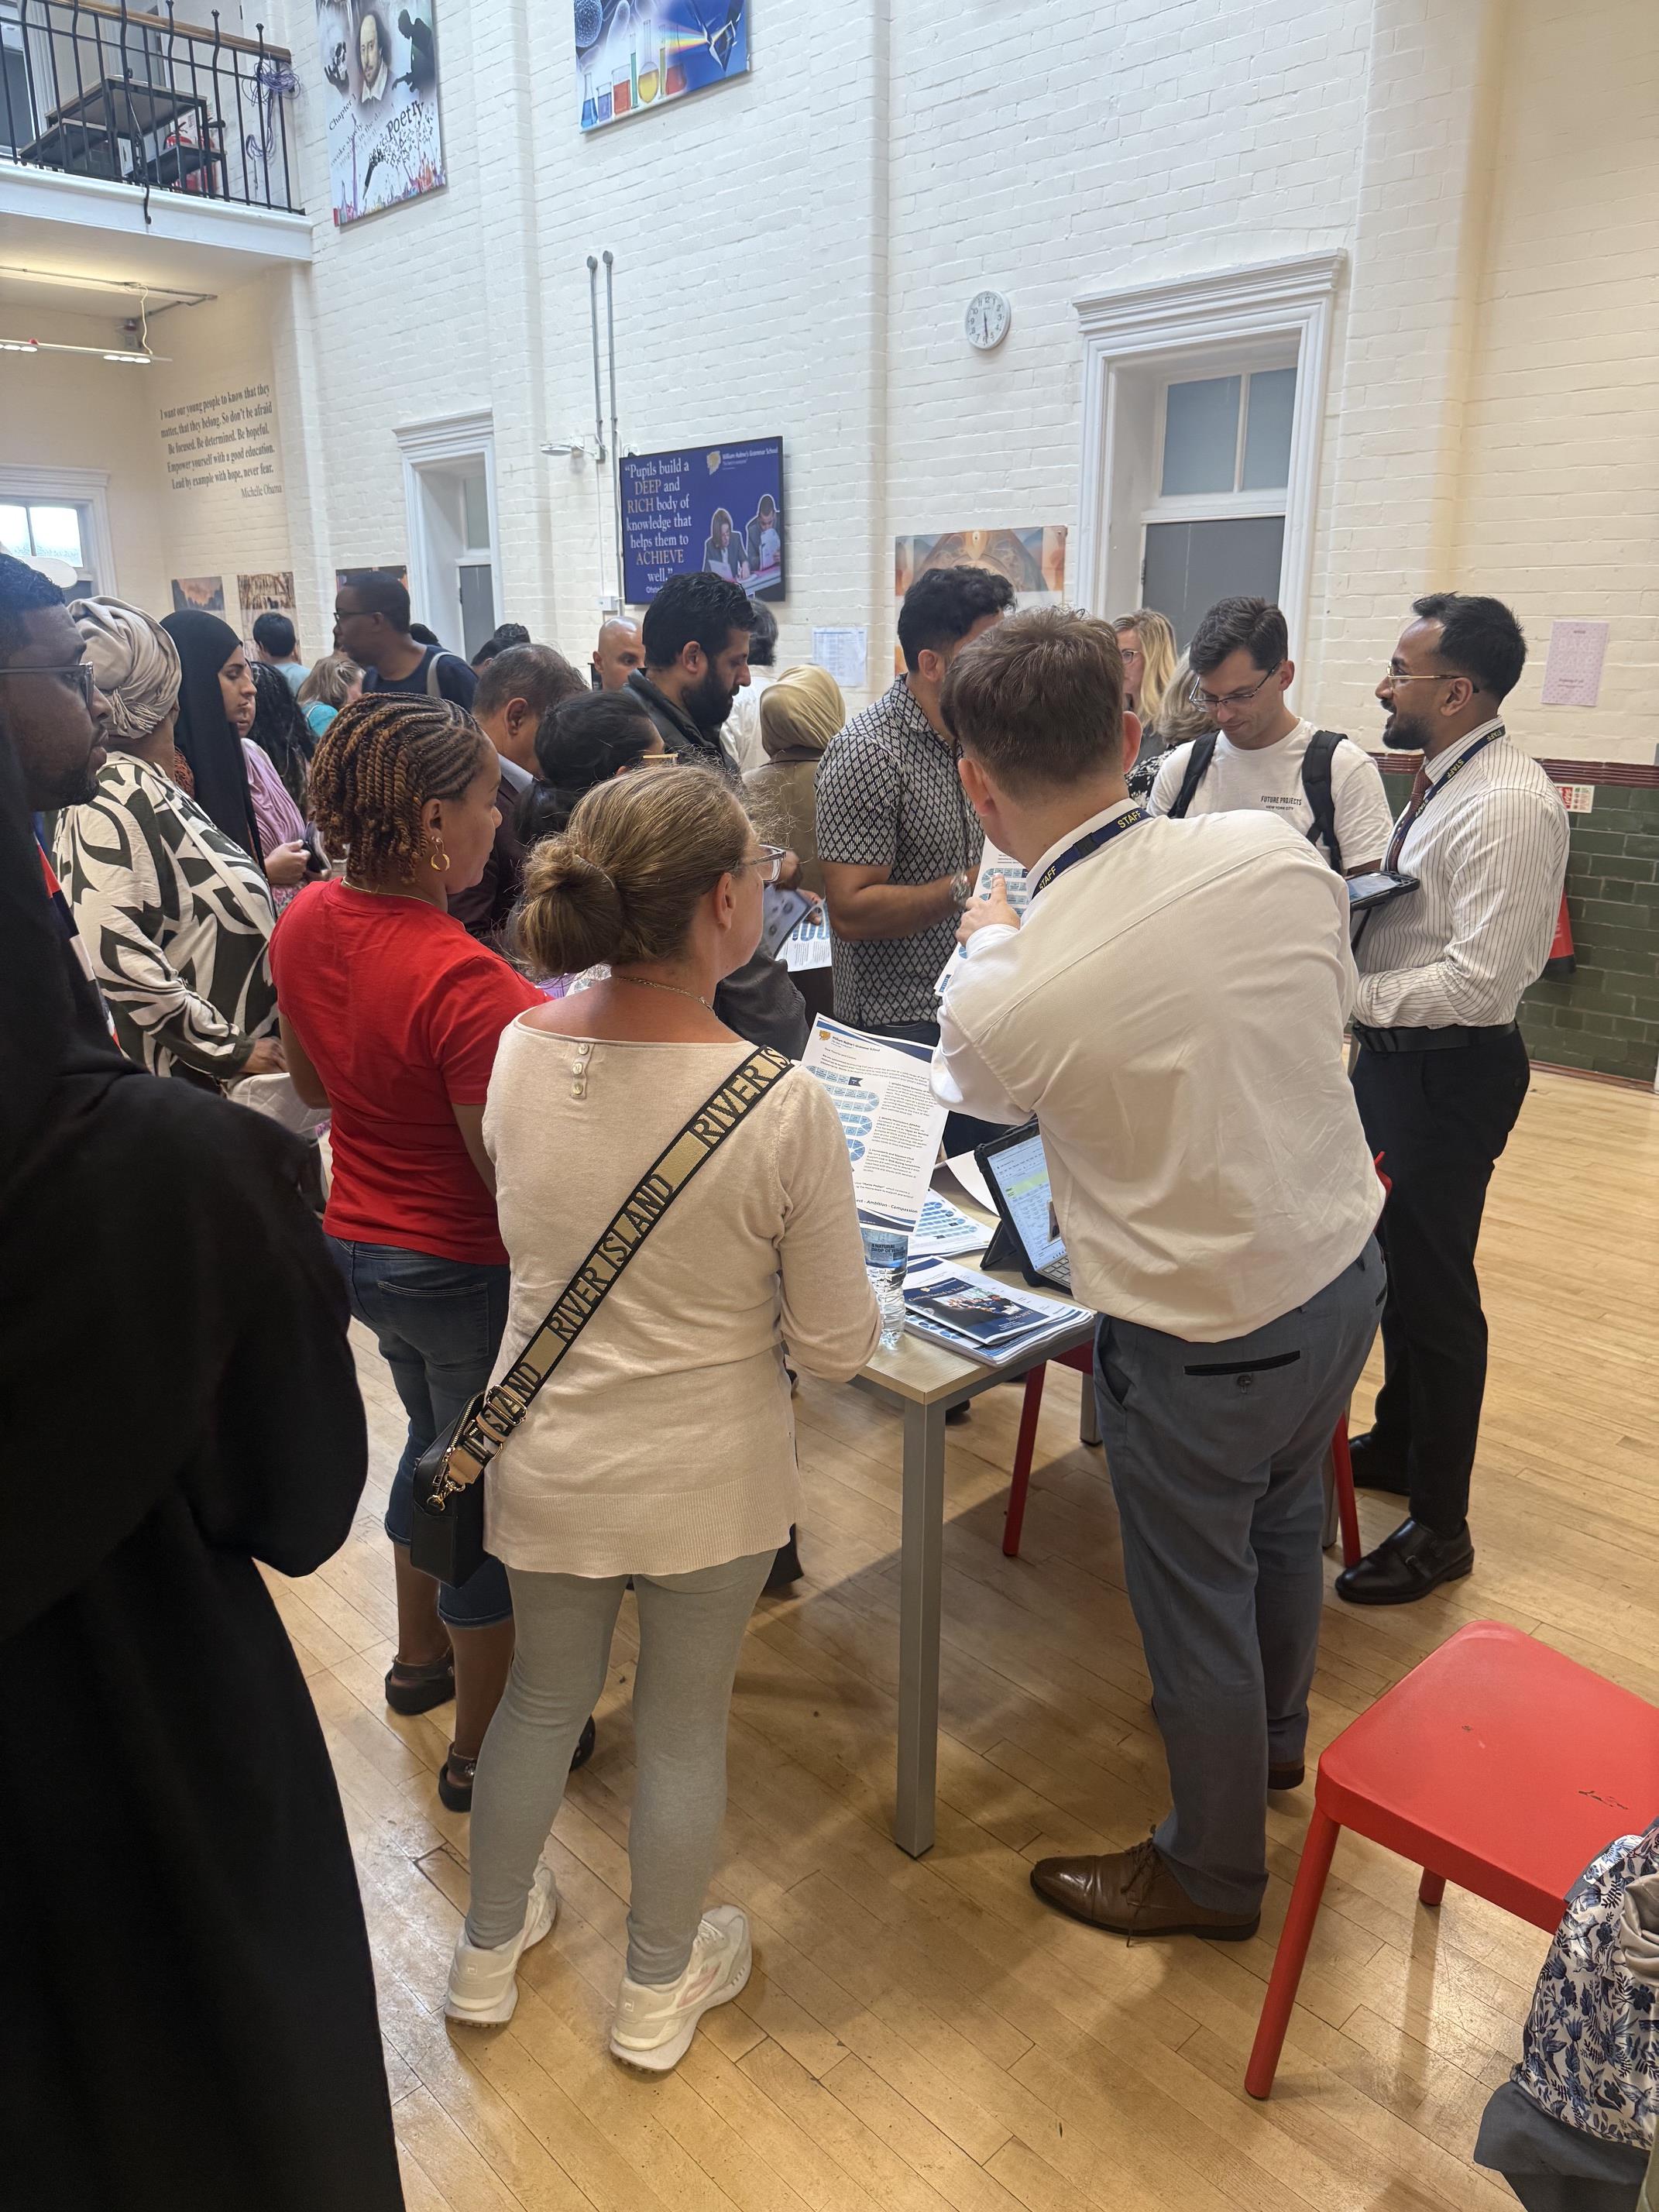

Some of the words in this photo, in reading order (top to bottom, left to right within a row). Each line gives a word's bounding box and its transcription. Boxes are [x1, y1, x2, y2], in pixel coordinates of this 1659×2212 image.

[329, 100, 352, 130] Chapter
[163, 407, 177, 418] want
[177, 407, 186, 416] our
[187, 402, 203, 417] young
[203, 396, 221, 413] people
[221, 395, 227, 405] to
[228, 392, 243, 403] know
[244, 386, 256, 399] that
[257, 383, 270, 397] they
[179, 423, 190, 434] that
[190, 420, 201, 434] they
[201, 416, 222, 429] belong.
[222, 411, 229, 424] So
[230, 408, 245, 422] don't
[246, 407, 253, 418] be
[254, 400, 273, 417] afraid
[168, 443, 175, 455] Be
[175, 438, 196, 453] focused.
[197, 437, 204, 449] Be
[204, 429, 236, 448] determined.
[237, 428, 245, 441] Be
[246, 422, 270, 441] hopeful.
[167, 461, 191, 475] Empower
[191, 453, 212, 471] yourself
[213, 452, 225, 464] with
[231, 447, 244, 465] good
[246, 442, 275, 458] education.
[659, 458, 682, 476] build
[684, 462, 689, 472] a
[172, 477, 185, 489] Lead
[185, 476, 192, 489] by
[193, 472, 214, 487] example
[215, 469, 227, 482] with
[227, 469, 243, 483] hope,
[243, 466, 259, 478] never
[259, 462, 274, 475] fear.
[241, 485, 263, 498] Michelle
[263, 483, 283, 496] Obama
[634, 479, 661, 496] DEEP
[664, 476, 680, 493] and
[627, 497, 654, 514] RICH
[656, 496, 678, 513] body
[680, 493, 689, 509] of
[626, 514, 672, 532] knowledge
[674, 515, 692, 527] that
[630, 533, 652, 551] helps
[654, 533, 677, 547] them
[679, 534, 689, 546] to
[636, 549, 684, 566] ACHIEVE
[1447, 759, 1464, 778] STAFF
[1261, 795, 1279, 804] FUTURE
[1279, 797, 1302, 805] PROJECTS
[1118, 810, 1142, 829] STAFF
[1039, 865, 1056, 890] STAFF
[694, 1064, 770, 1147] RIVER
[867, 1199, 888, 1207] Ambition
[891, 1204, 918, 1214] Compassion
[545, 1264, 608, 1342] RIVER
[597, 1173, 675, 1271] ISLAND
